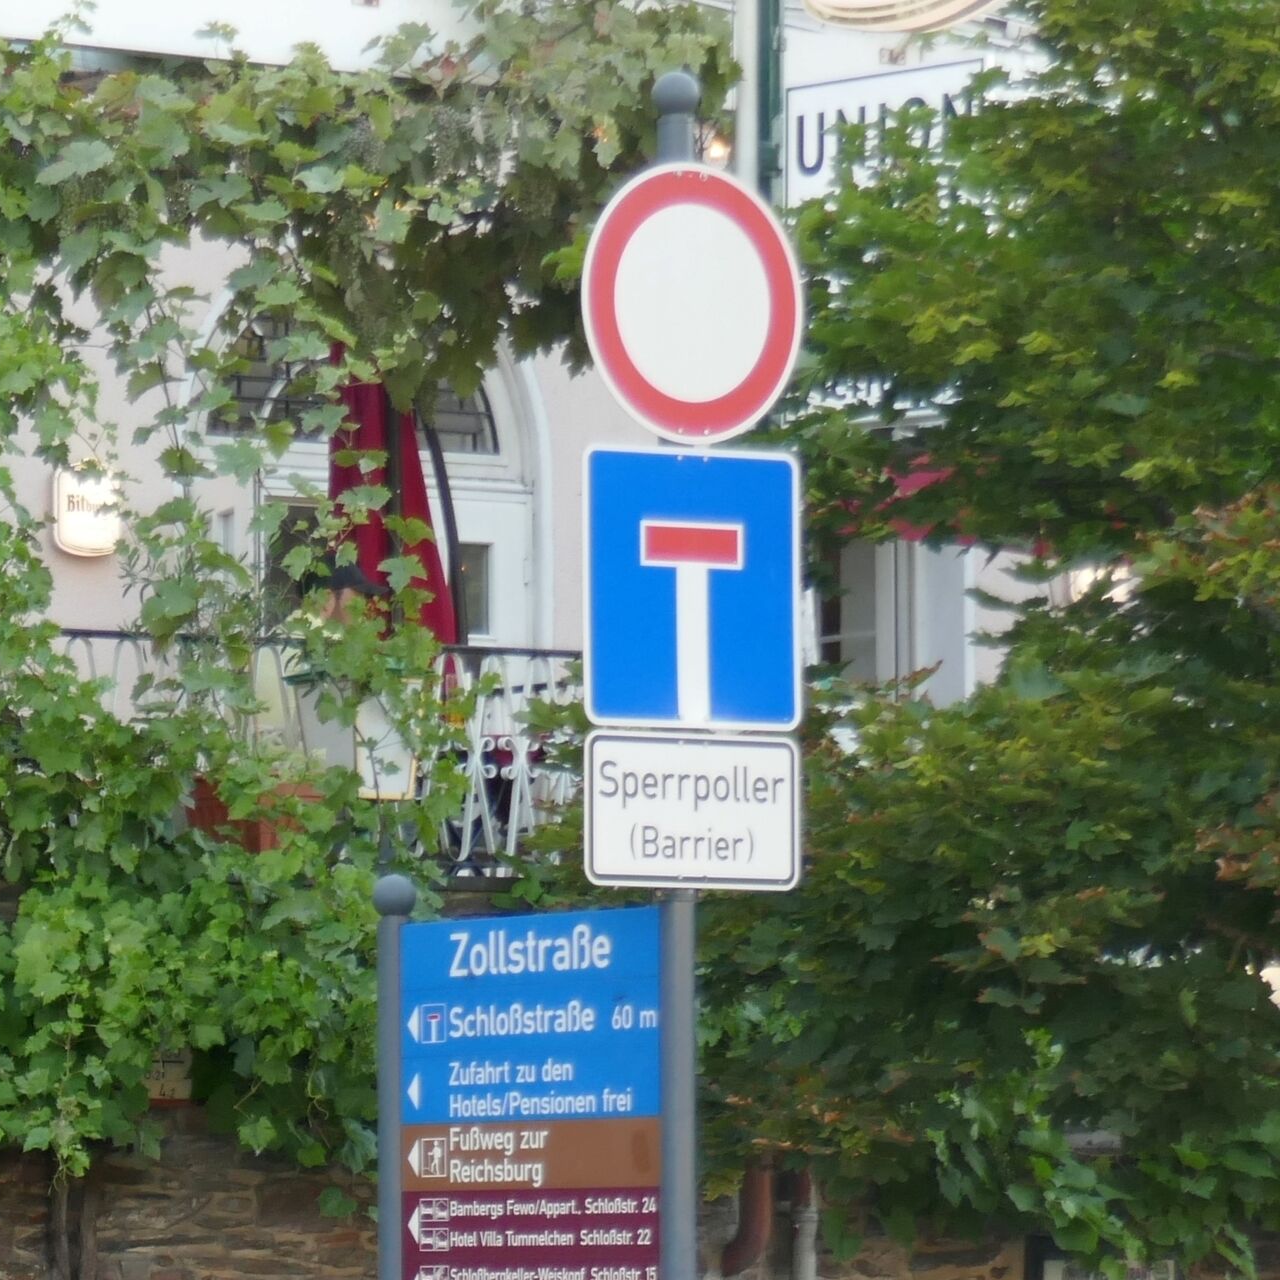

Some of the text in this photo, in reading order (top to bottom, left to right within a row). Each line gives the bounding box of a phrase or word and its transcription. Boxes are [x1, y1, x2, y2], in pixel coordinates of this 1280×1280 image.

[599, 760, 785, 812] Sperrpoller
[630, 822, 754, 864] (Barrier)
[449, 924, 611, 977] Zollstraße
[449, 999, 657, 1038] Schloßstraße 60 m
[449, 1057, 573, 1086] Zufahrt zu den
[449, 1087, 633, 1118] Hotels/Pensionen frei
[450, 1126, 549, 1155] Fußweg zur
[450, 1157, 543, 1188] Reichsburg
[450, 1200, 504, 1220] Bambergs
[585, 1197, 639, 1215] Schloßstr.
[642, 1196, 657, 1214] 24
[450, 1231, 477, 1248] Hotel
[480, 1230, 504, 1247] Villa
[580, 1228, 634, 1246] Schloßstr.
[637, 1228, 651, 1246] 22
